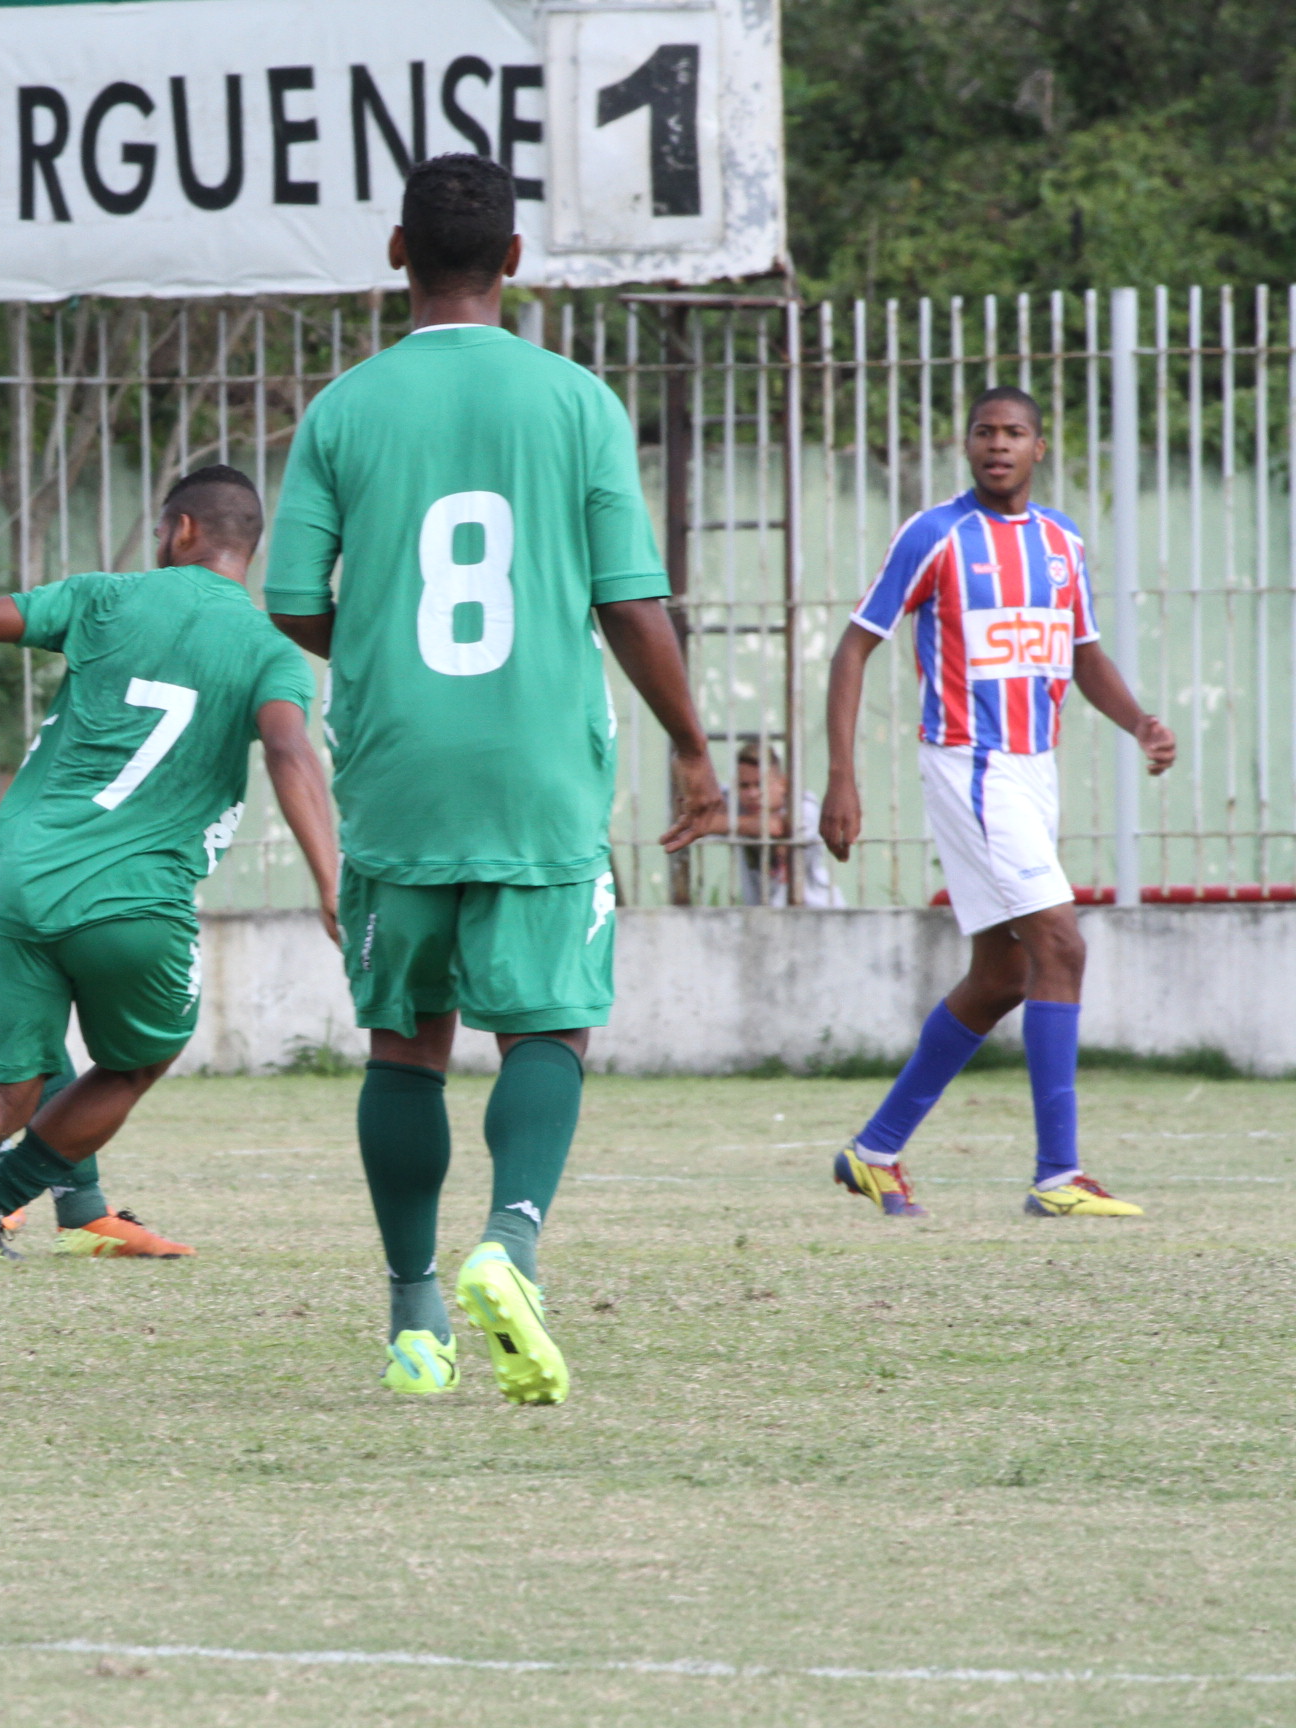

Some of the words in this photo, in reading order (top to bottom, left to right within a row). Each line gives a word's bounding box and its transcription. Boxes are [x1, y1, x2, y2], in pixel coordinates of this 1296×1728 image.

[597, 43, 701, 218] 1
[416, 489, 514, 676] 8
[93, 676, 199, 812] 7
